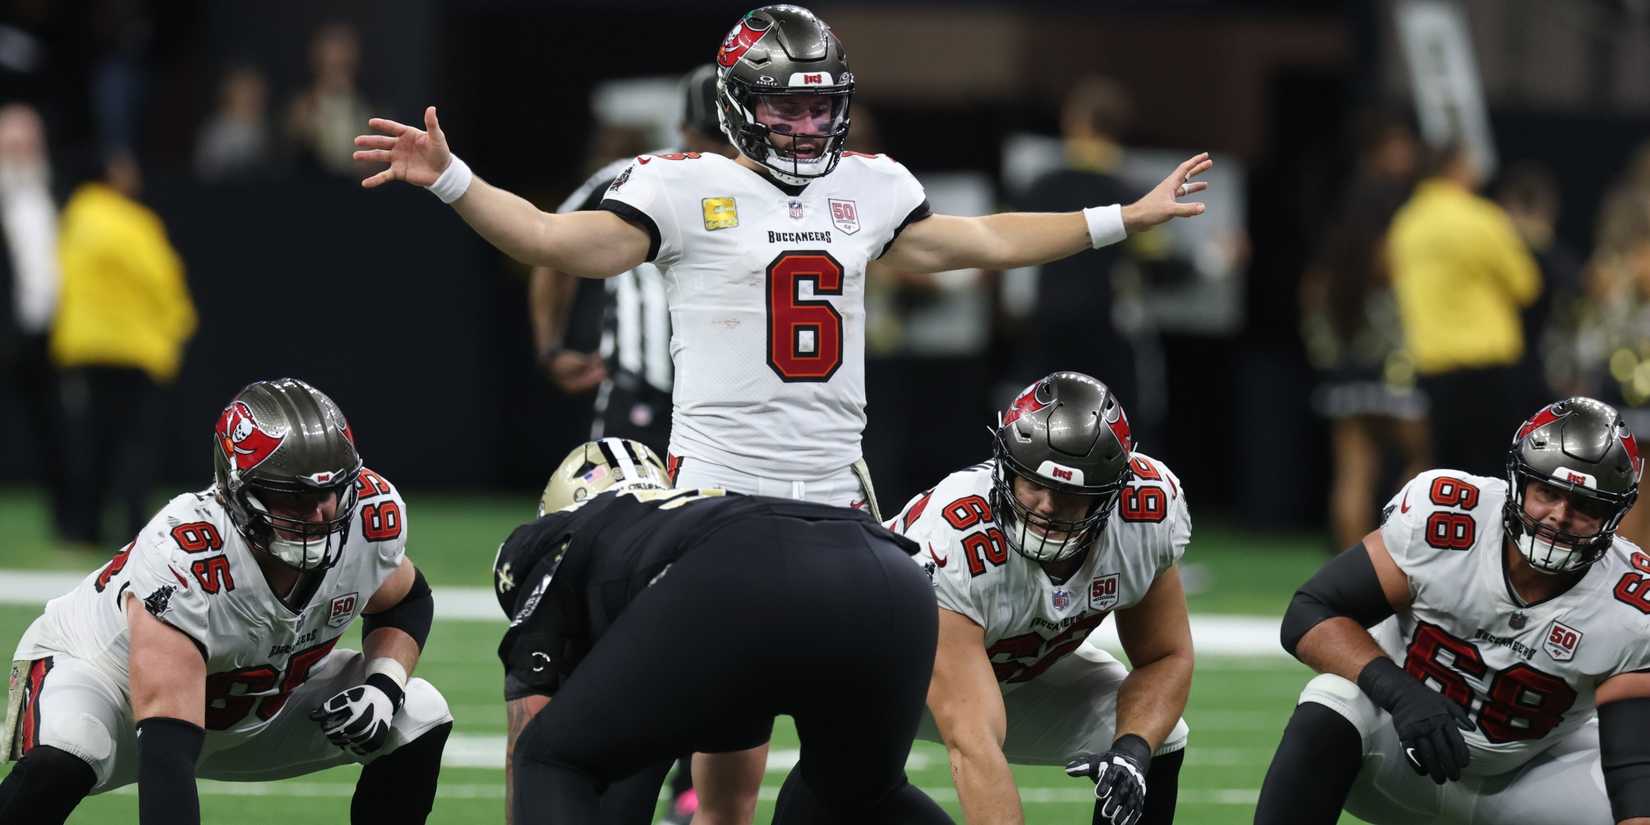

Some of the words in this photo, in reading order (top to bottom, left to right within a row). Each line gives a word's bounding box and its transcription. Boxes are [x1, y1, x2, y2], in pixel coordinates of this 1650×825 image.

[767, 230, 832, 244] BUCCANEERS
[831, 202, 856, 221] 50
[765, 250, 844, 383] 6
[358, 468, 402, 543] 65
[1118, 455, 1167, 524] 62
[1425, 476, 1480, 551] 68
[169, 521, 235, 595] 65
[941, 494, 1008, 578] 62
[333, 596, 355, 617] 50
[1092, 578, 1117, 598] 50
[1549, 624, 1577, 650] 50
[1404, 620, 1577, 744] 68
